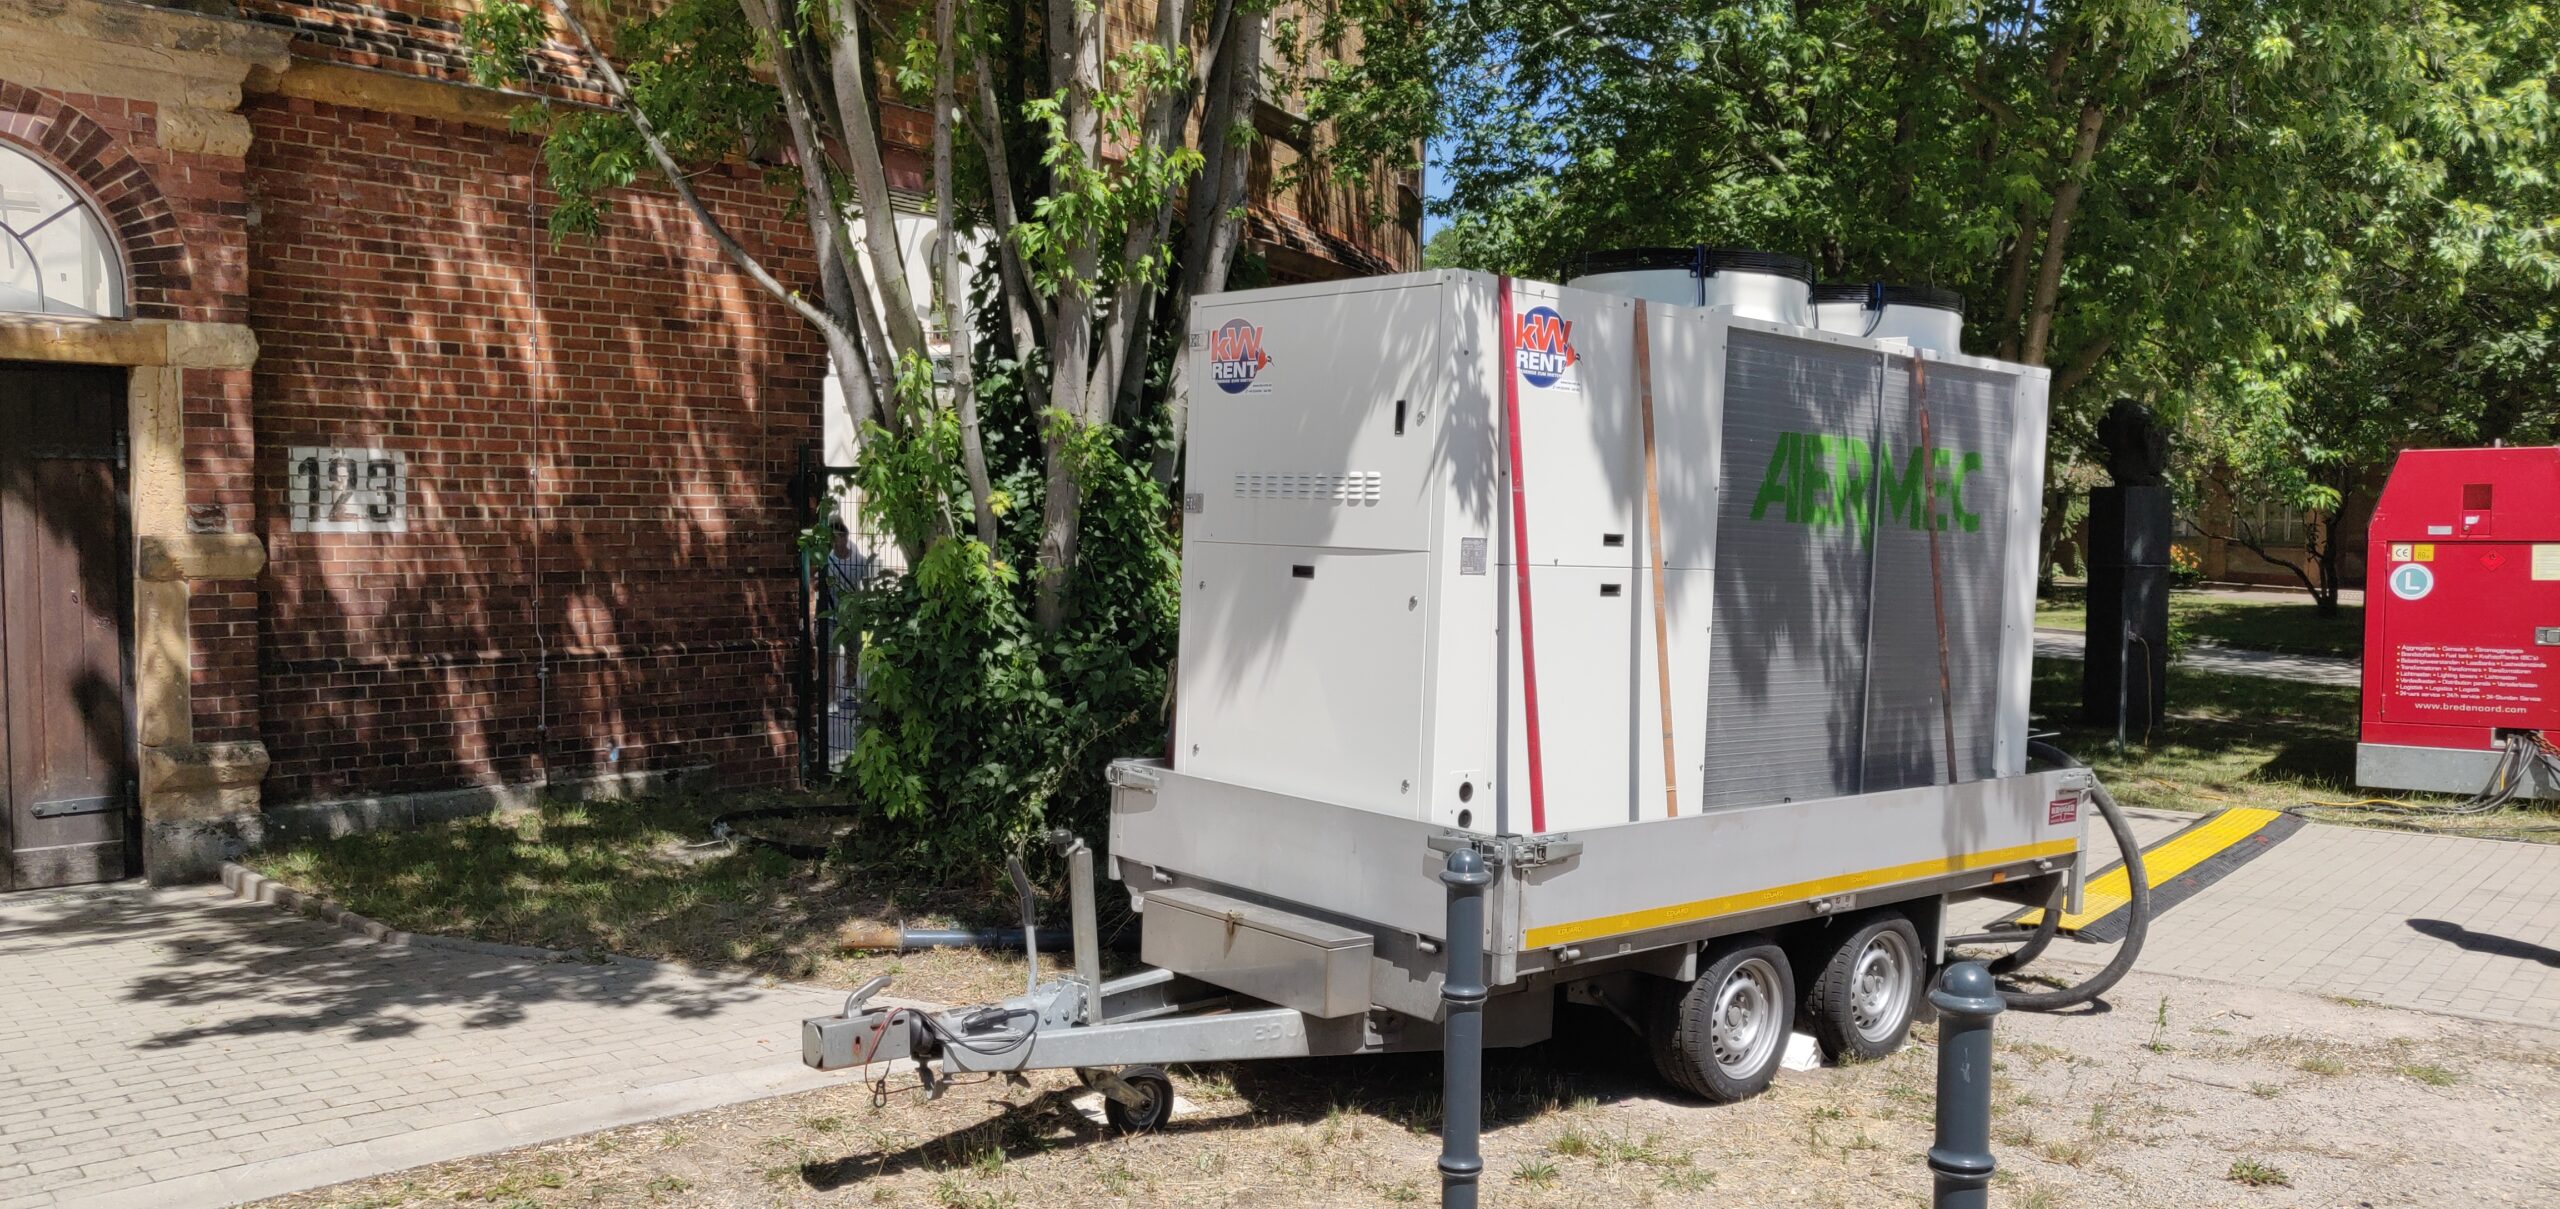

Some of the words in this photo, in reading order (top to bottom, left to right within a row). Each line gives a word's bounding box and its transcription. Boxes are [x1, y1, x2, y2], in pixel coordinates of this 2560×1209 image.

[1210, 326, 1264, 361] kW
[1515, 313, 1573, 354] kW
[1212, 361, 1258, 379] RENT
[1516, 350, 1567, 373] RENT
[298, 457, 396, 522] 123
[1750, 431, 1983, 553] AERMEC
[2405, 571, 2421, 590] L
[2415, 702, 2527, 714] www.bredenoord.com
[1254, 1022, 1305, 1041] EDU
